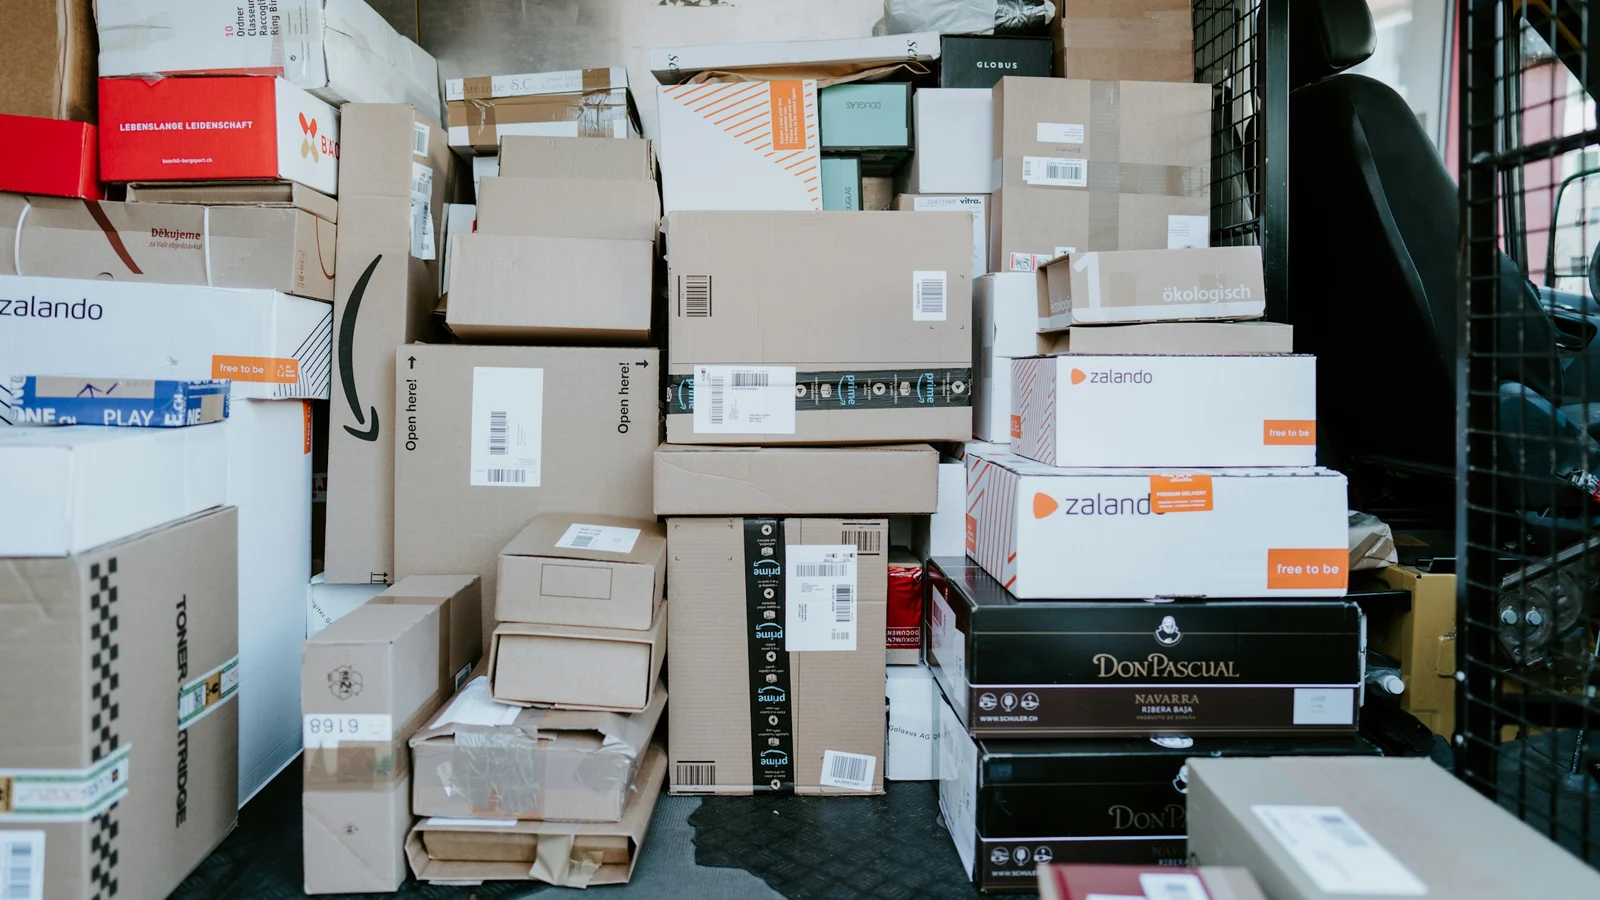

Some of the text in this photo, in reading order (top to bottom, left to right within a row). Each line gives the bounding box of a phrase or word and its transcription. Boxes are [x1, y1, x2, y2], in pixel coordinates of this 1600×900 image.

[236, 6, 245, 37] Ordner
[270, 15, 281, 36] Ring
[225, 25, 234, 37] 10
[976, 60, 1018, 70] GLOBUS
[511, 77, 535, 91] S.C.
[846, 101, 882, 110] DOUGLAS
[119, 120, 253, 132] LEBENSLANGE LEIDENSCHAFT
[151, 227, 201, 241] Děkujeme
[1072, 252, 1101, 309] 1
[1162, 284, 1251, 304] ökologisch
[0, 295, 103, 321] zalando
[220, 363, 264, 374] free to be
[1091, 368, 1153, 385] zalando
[845, 375, 857, 405] prime
[924, 372, 936, 404] prime
[617, 361, 632, 434] Open here!
[103, 408, 155, 427] PLAY
[405, 378, 419, 452] Open here!
[1269, 428, 1310, 437] free to be
[1066, 492, 1158, 517] zaland
[753, 566, 781, 577] prime
[1276, 562, 1340, 575] free to be
[176, 594, 188, 682] TONER
[755, 629, 783, 641] prime
[758, 693, 786, 704] prime
[1134, 693, 1200, 705] NAVARRA
[1141, 705, 1193, 714] RIBERA BAJA
[310, 718, 359, 734] 6168
[979, 715, 1039, 723] WWW.SCHULER.CH
[888, 725, 917, 737] Galaxus
[919, 733, 931, 741] AG
[760, 756, 788, 767] prime
